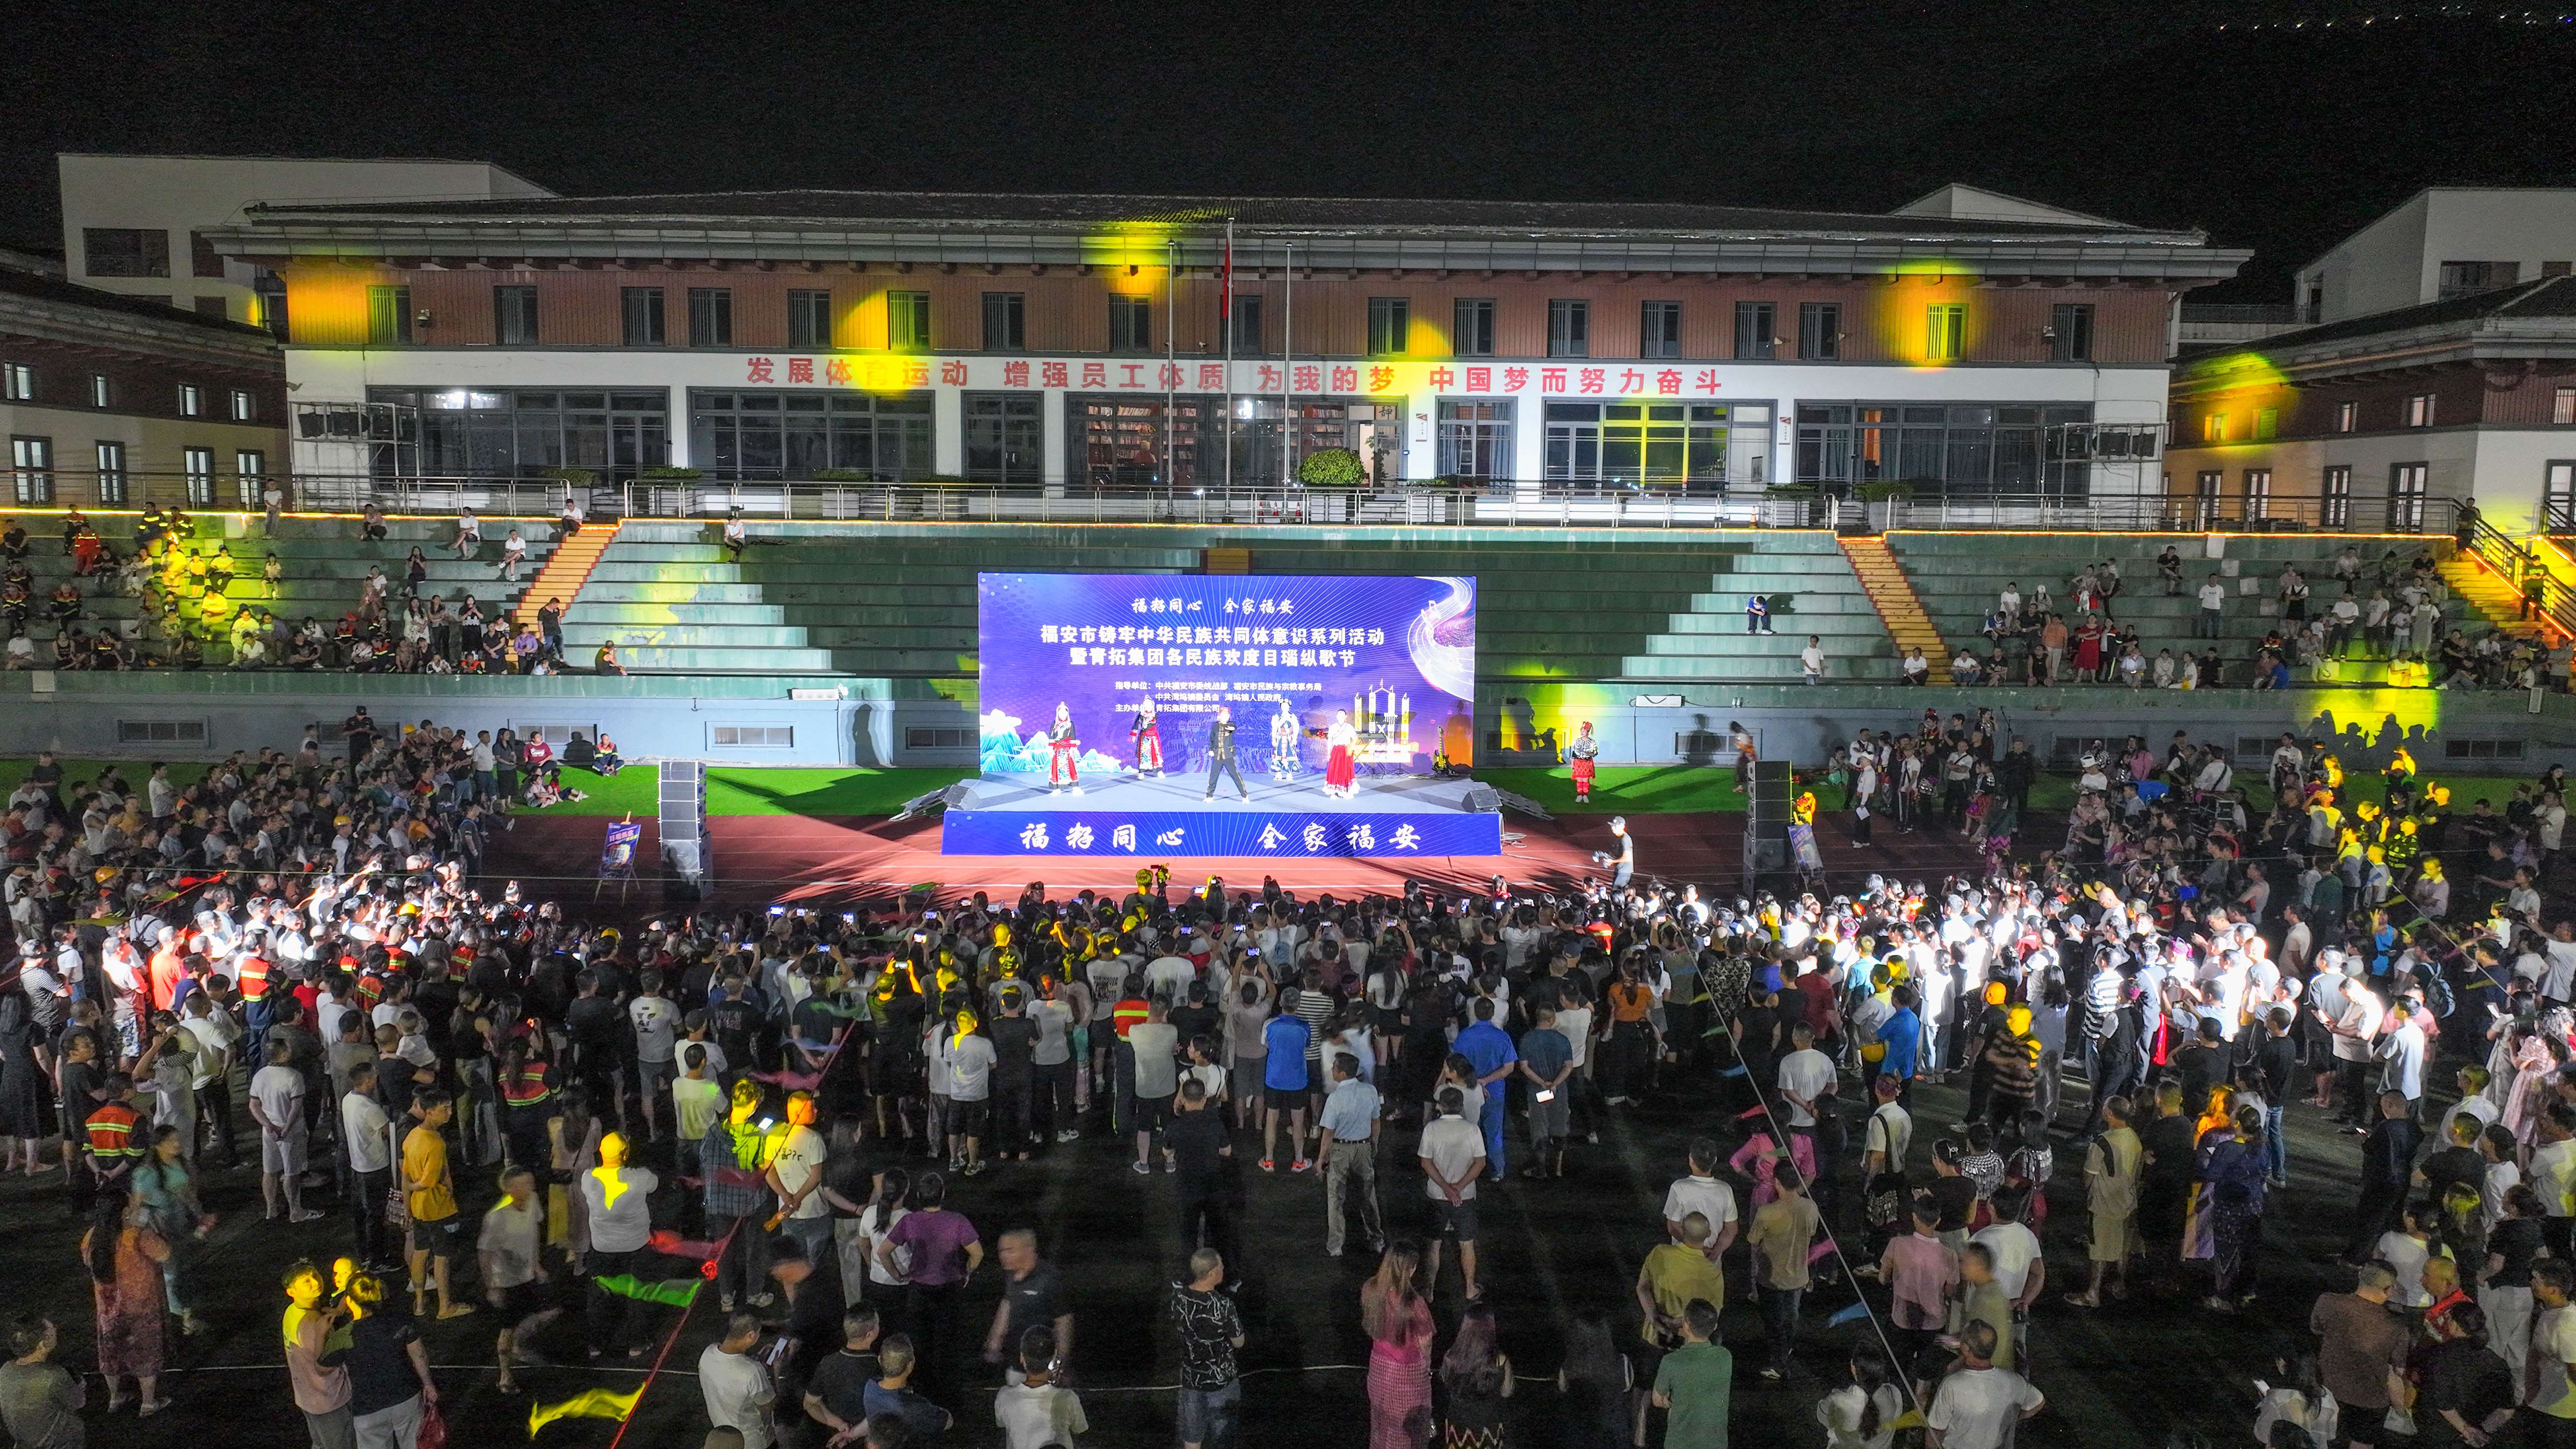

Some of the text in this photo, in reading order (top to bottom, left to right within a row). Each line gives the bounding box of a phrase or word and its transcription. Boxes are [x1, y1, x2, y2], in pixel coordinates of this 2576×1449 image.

[748, 358, 1722, 395] 发展体育运动 增强员工体质 为我的梦 中国梦而努力奋斗
[1223, 597, 1294, 615] 全家福安
[1040, 624, 1385, 646] 福安市铸牢中华民族共同体意识系列活动
[1070, 647, 1356, 668] 暨青拓集团各民族欢度目瑙纵歌节
[1257, 822, 1422, 852] 全家福安
